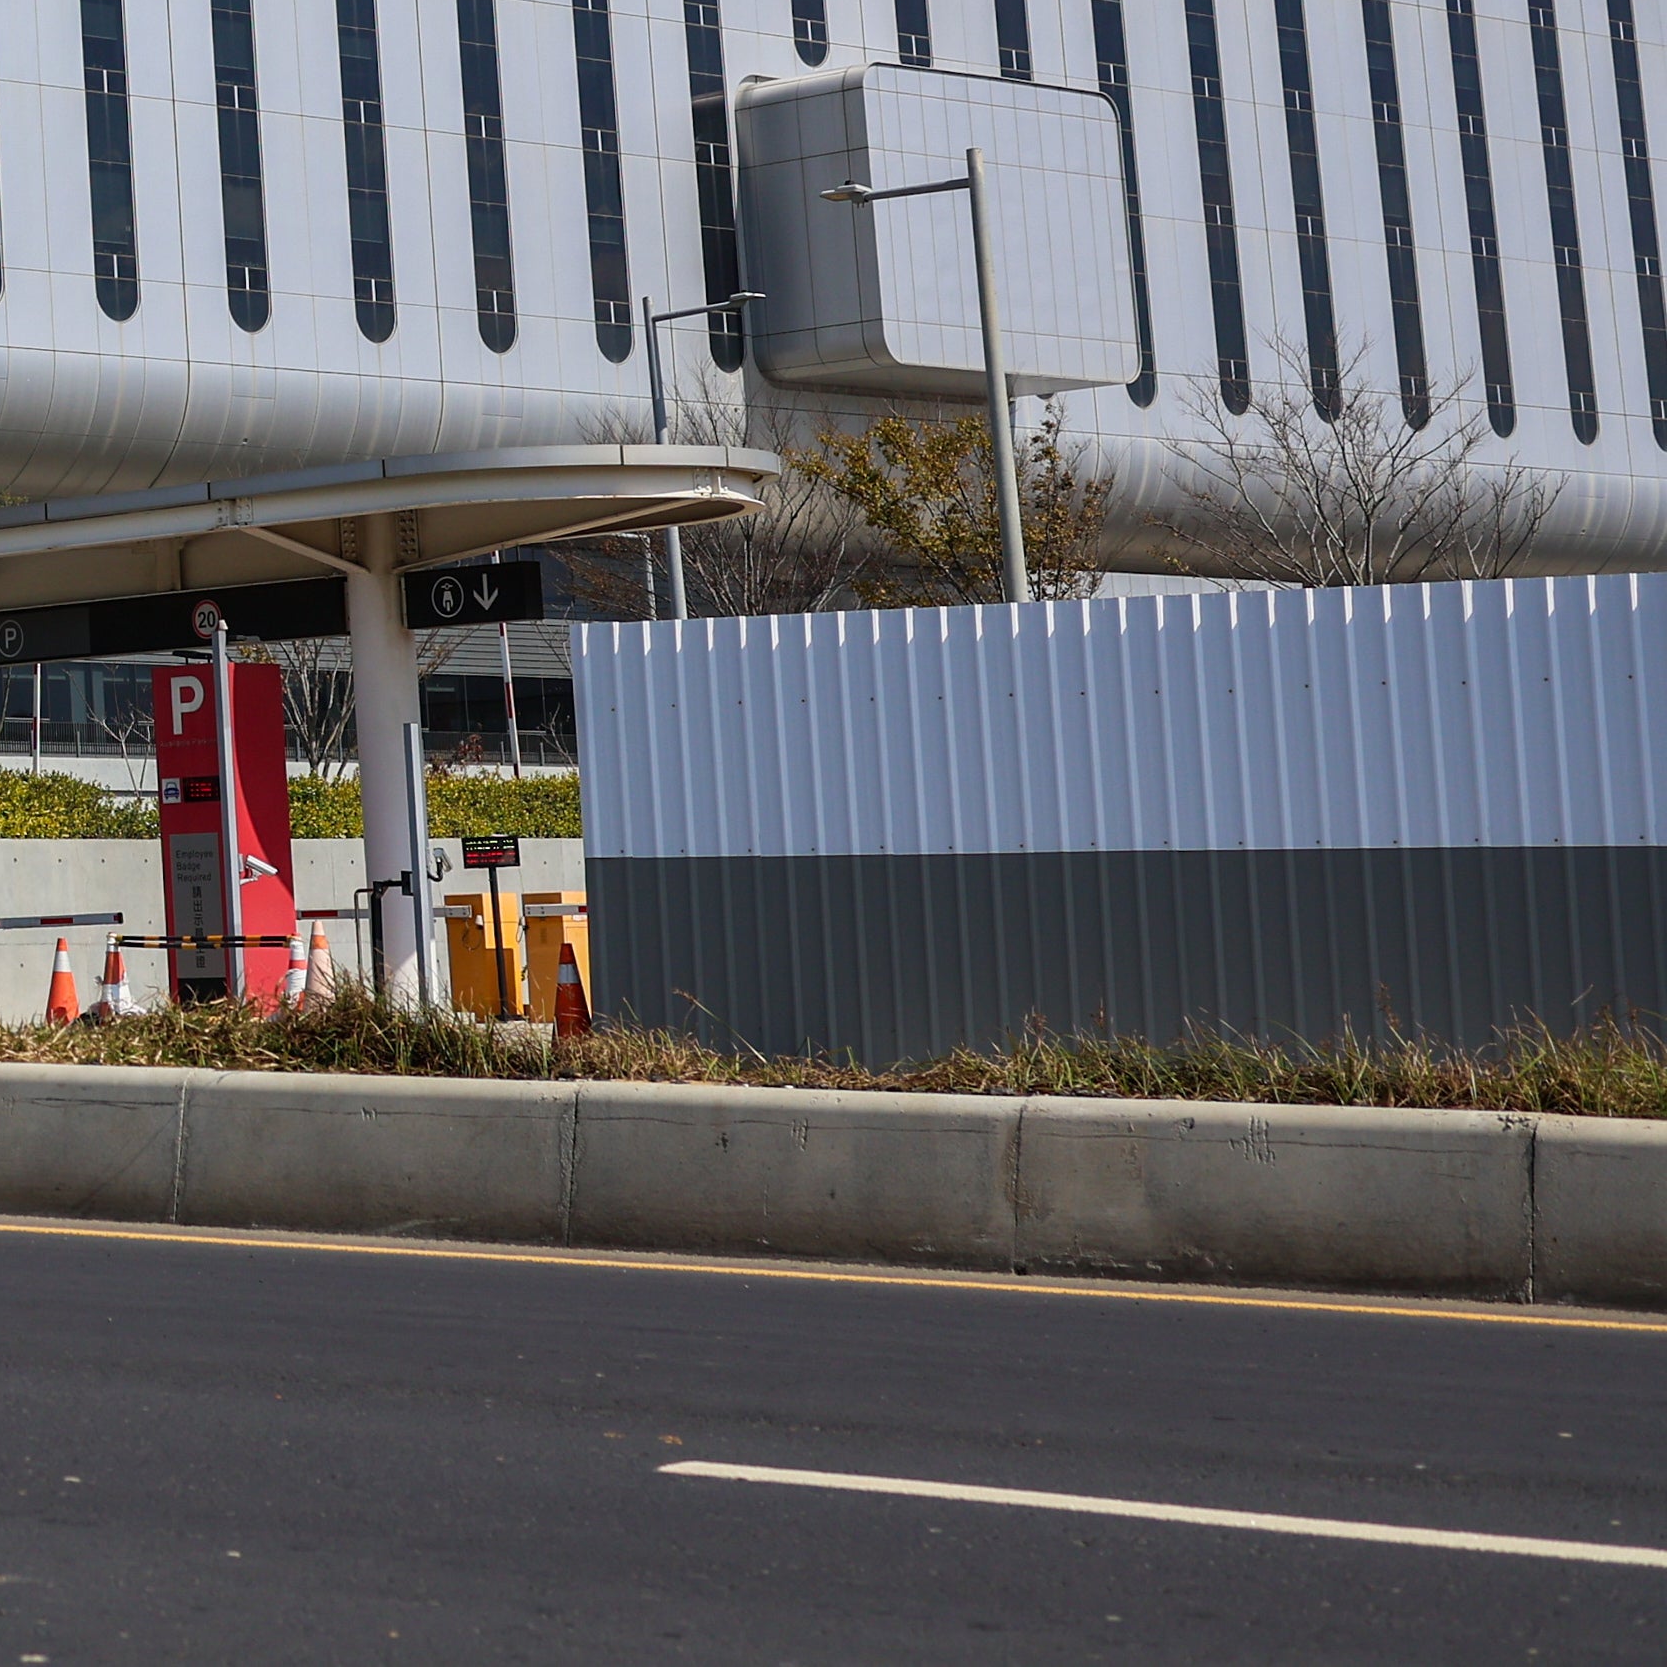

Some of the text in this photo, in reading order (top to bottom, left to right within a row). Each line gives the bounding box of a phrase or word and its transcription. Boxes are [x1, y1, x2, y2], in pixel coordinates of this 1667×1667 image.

[197, 610, 216, 629] 20
[170, 675, 205, 736] P
[177, 872, 212, 883] Required
